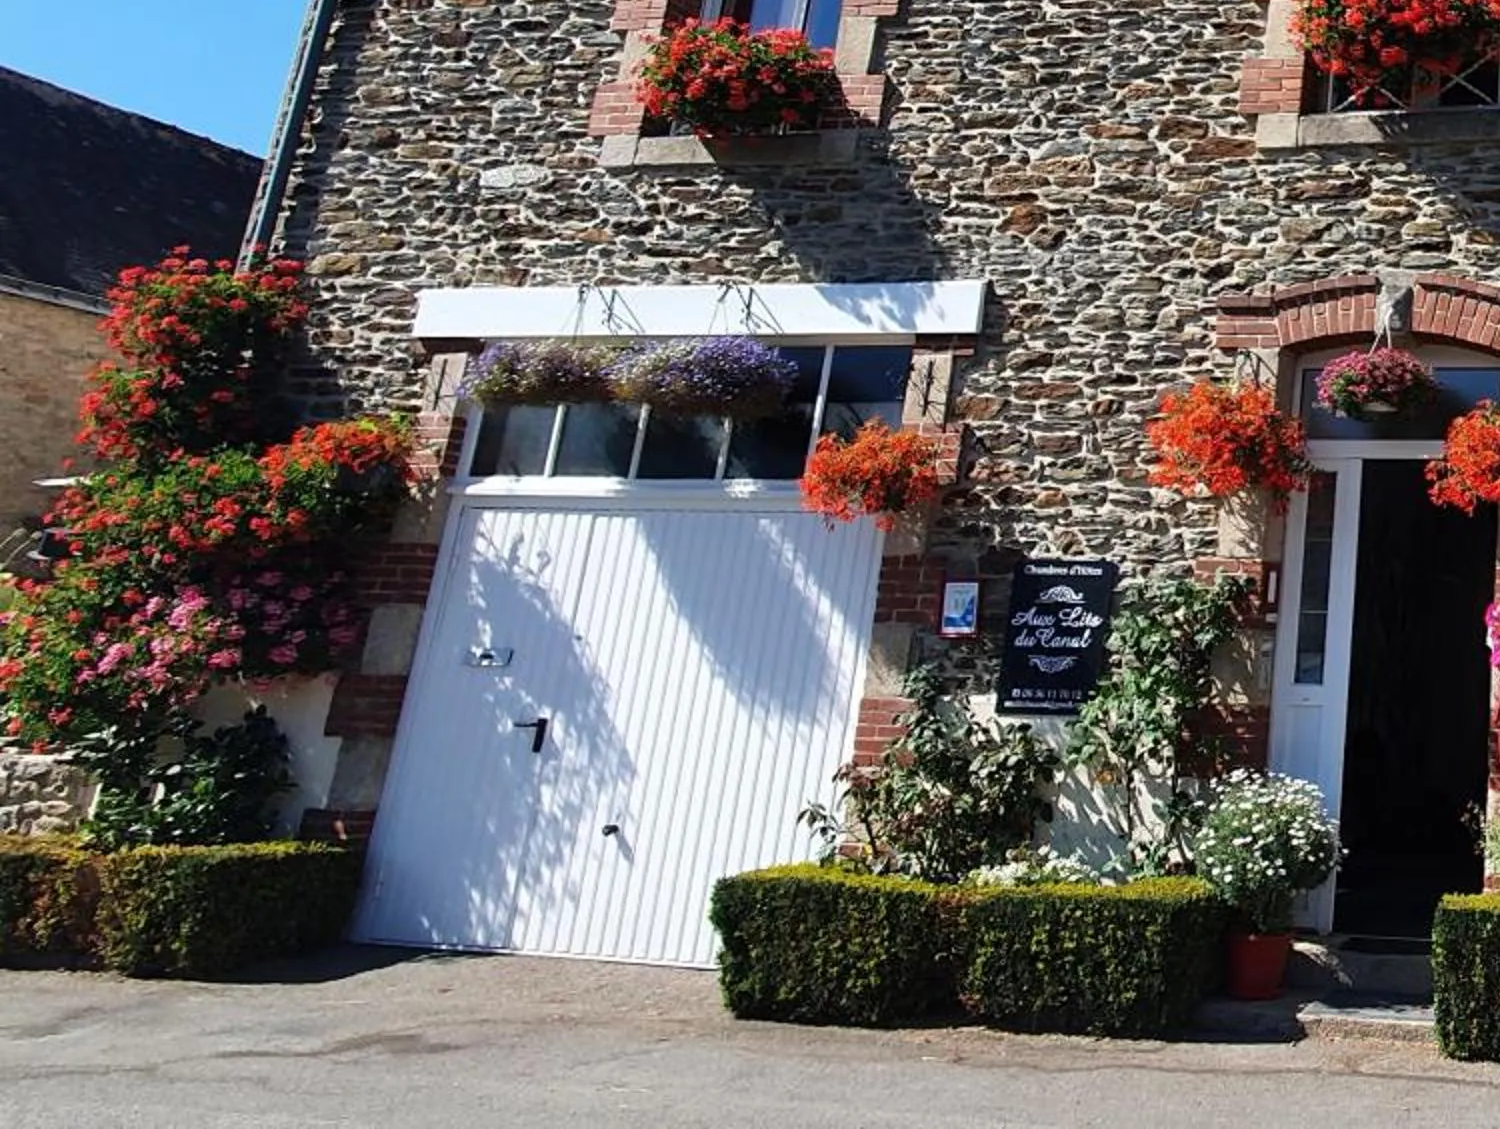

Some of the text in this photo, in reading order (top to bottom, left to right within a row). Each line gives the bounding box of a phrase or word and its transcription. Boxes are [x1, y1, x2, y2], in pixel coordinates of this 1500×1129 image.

[1011, 606, 1103, 628] Aux Lits
[1014, 626, 1093, 648] du Canal
